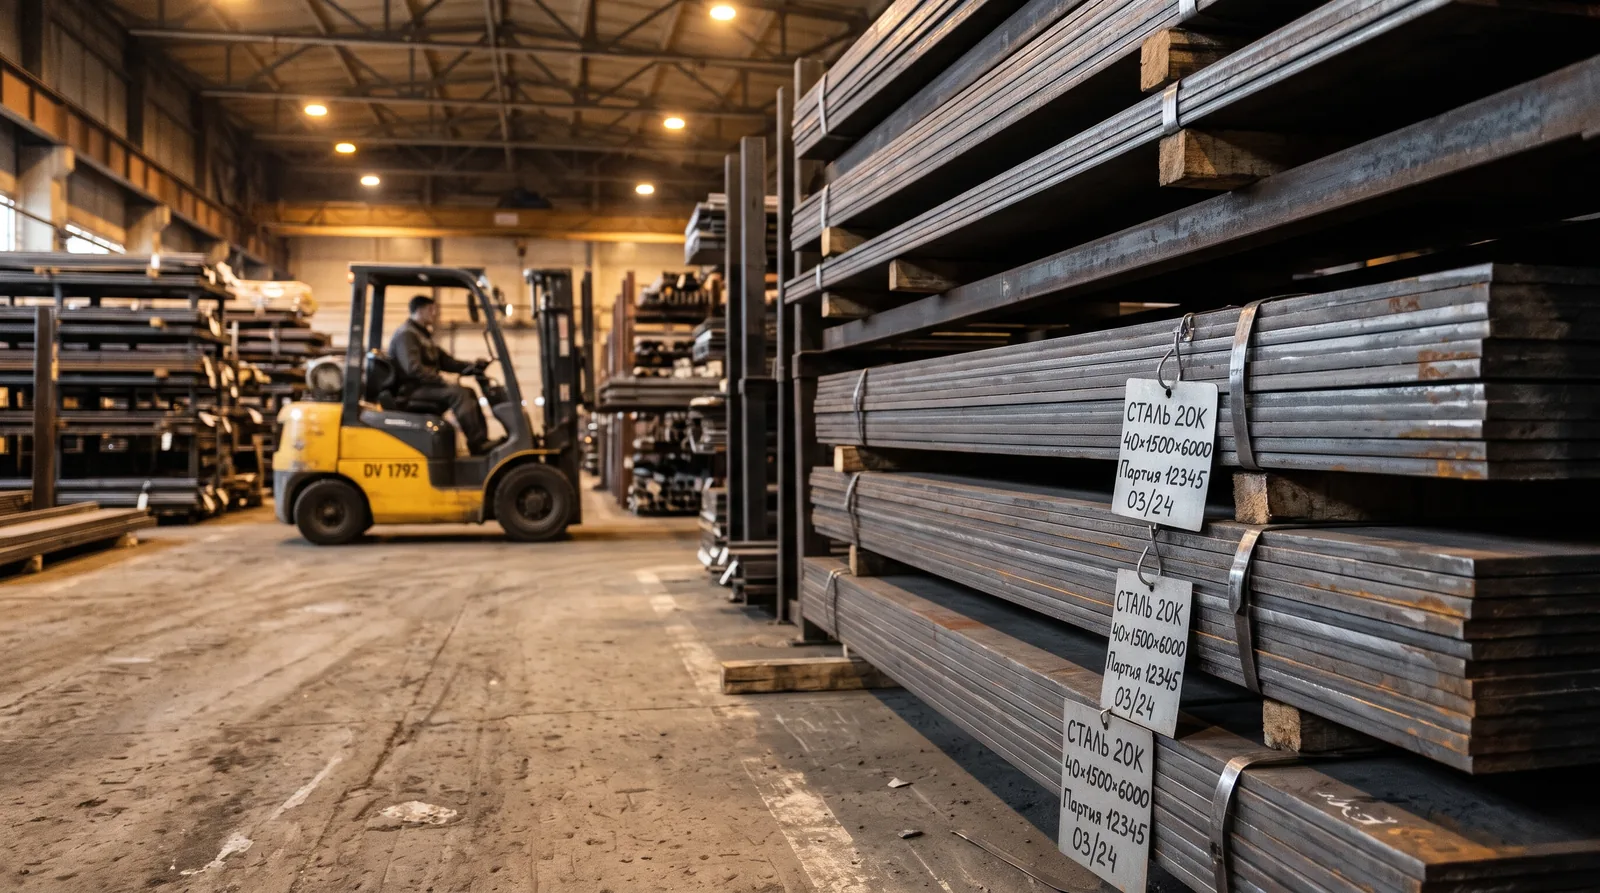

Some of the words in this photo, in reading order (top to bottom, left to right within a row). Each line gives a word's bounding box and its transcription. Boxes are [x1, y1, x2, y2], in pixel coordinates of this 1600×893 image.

[1127, 402, 1171, 426] СТАЛЬ
[1175, 405, 1208, 429] 20К
[364, 463, 382, 478] DV
[387, 463, 419, 478] 1792
[1119, 459, 1162, 487] Партия
[1165, 465, 1208, 490] 12345
[1127, 488, 1174, 517] 03/24
[1116, 590, 1152, 618] СТАЛЬ
[1156, 599, 1184, 626] 20К
[1106, 651, 1141, 680] Партия
[1145, 663, 1181, 691] 12345
[1114, 686, 1155, 721] 03/24
[1067, 719, 1110, 758] СТАЛЬ
[1113, 738, 1145, 773] 20К
[1063, 787, 1102, 826] Партия
[1106, 808, 1148, 846] 12345
[1072, 826, 1117, 874] 03/24
